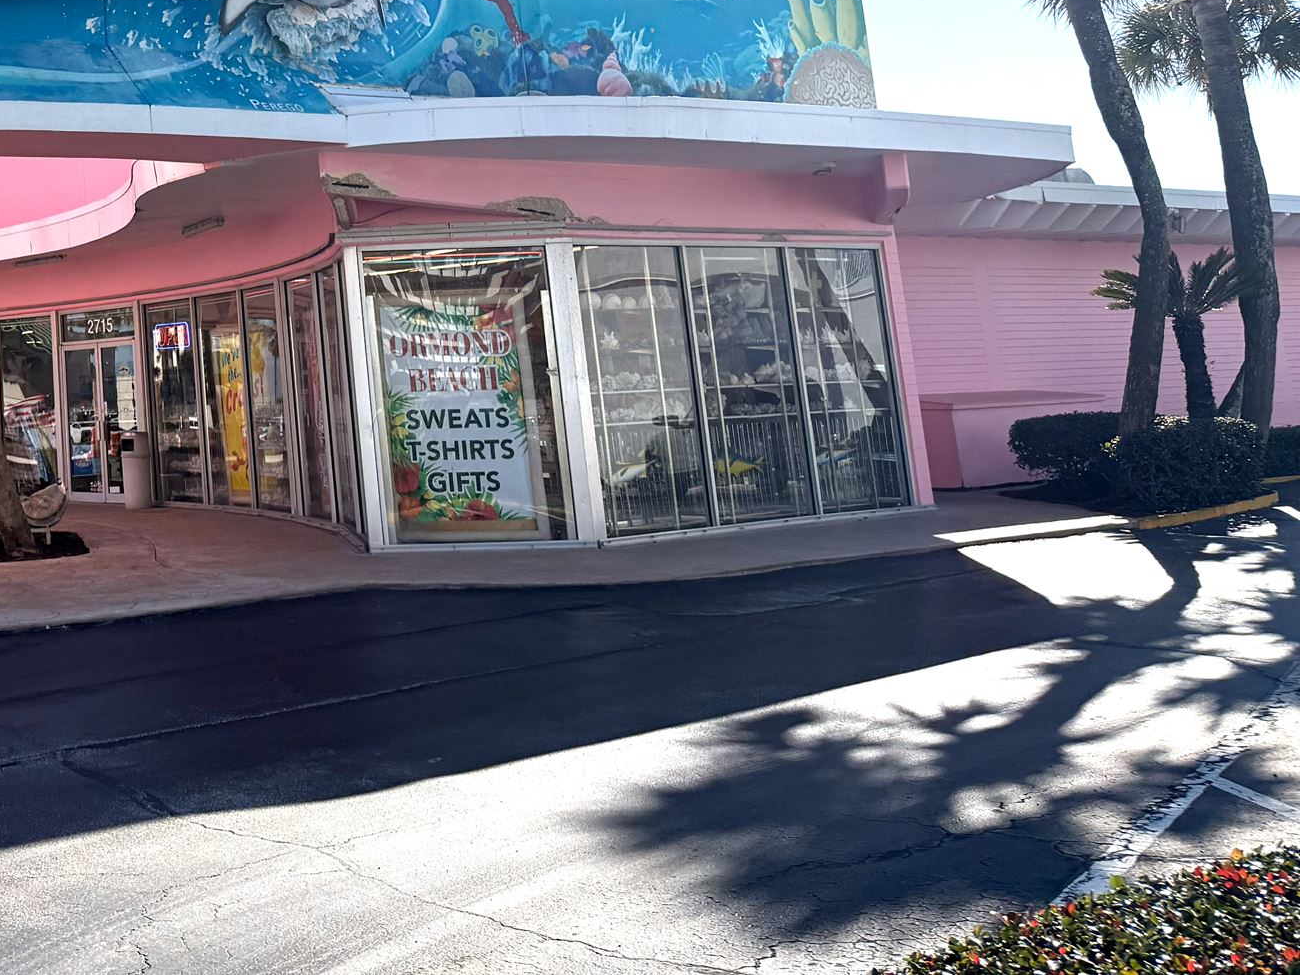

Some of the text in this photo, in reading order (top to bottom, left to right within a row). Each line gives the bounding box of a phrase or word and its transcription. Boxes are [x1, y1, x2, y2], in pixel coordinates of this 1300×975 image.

[87, 318, 113, 334] 2715
[388, 328, 512, 358] ORMOND
[408, 365, 499, 393] BEACH
[405, 407, 510, 430] SWEATS
[406, 439, 515, 462] T-SHIRTS
[428, 470, 501, 493] GIFTS
